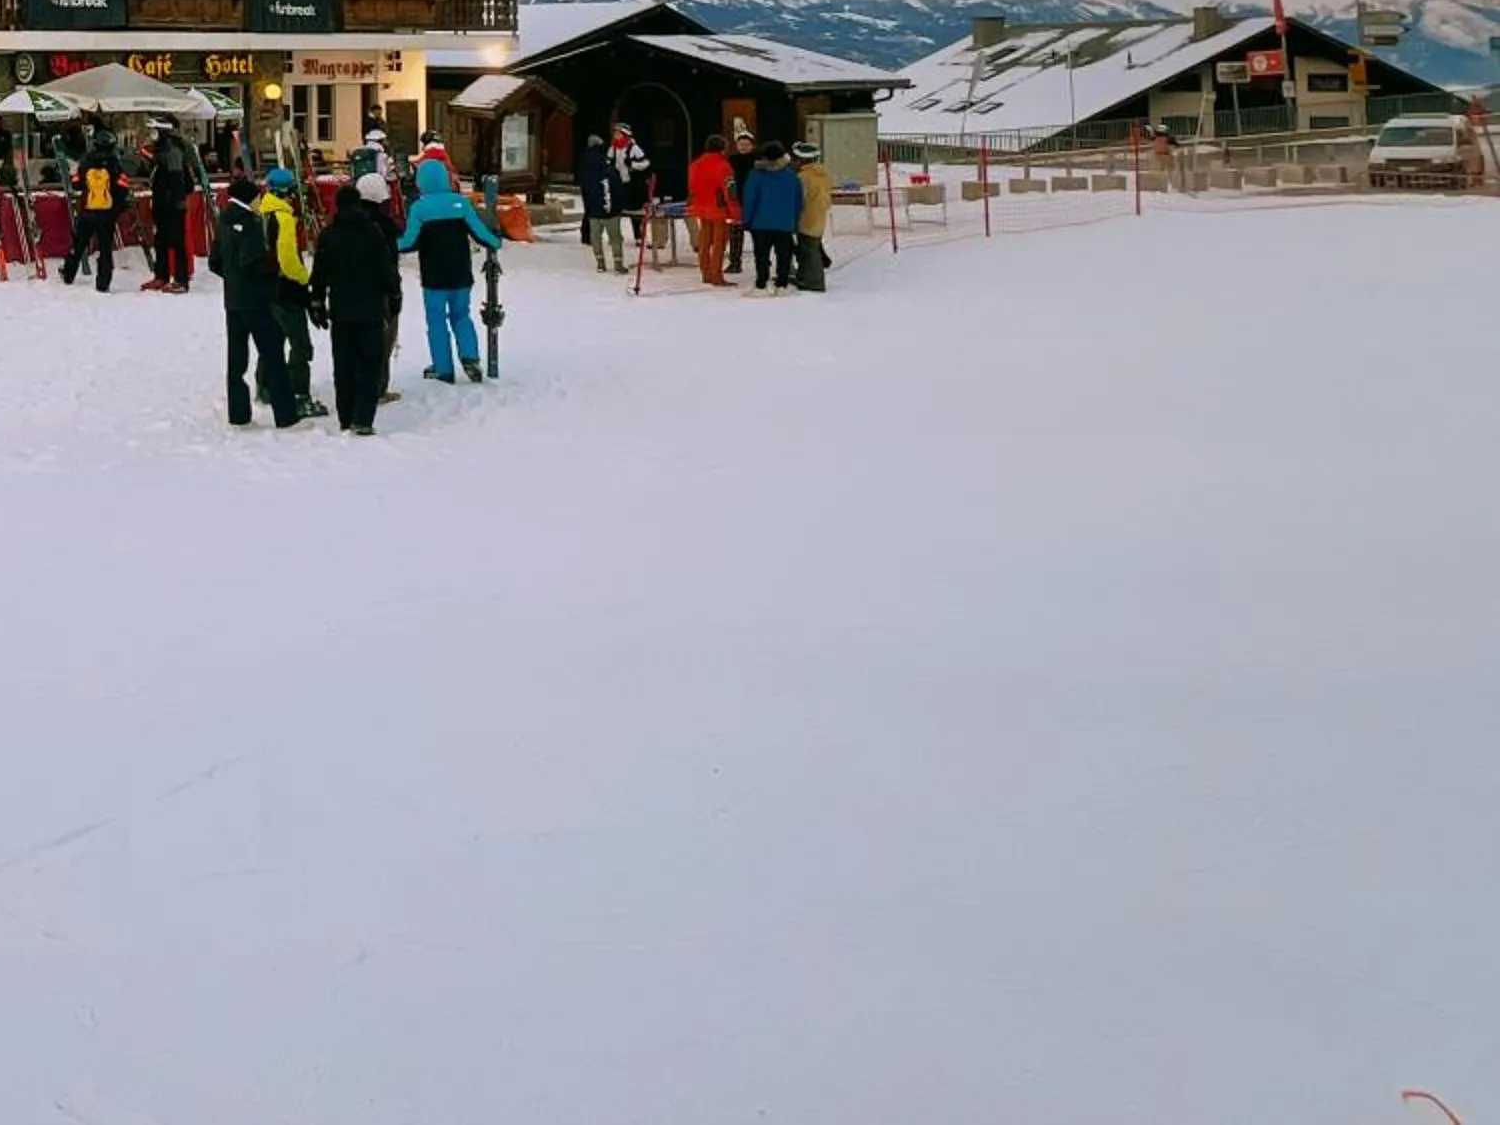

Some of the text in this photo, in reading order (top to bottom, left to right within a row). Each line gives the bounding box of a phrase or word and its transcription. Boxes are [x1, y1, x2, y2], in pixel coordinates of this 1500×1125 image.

[127, 53, 173, 79] Café
[204, 54, 254, 81] Hotel
[302, 58, 374, 80] Magrappe
